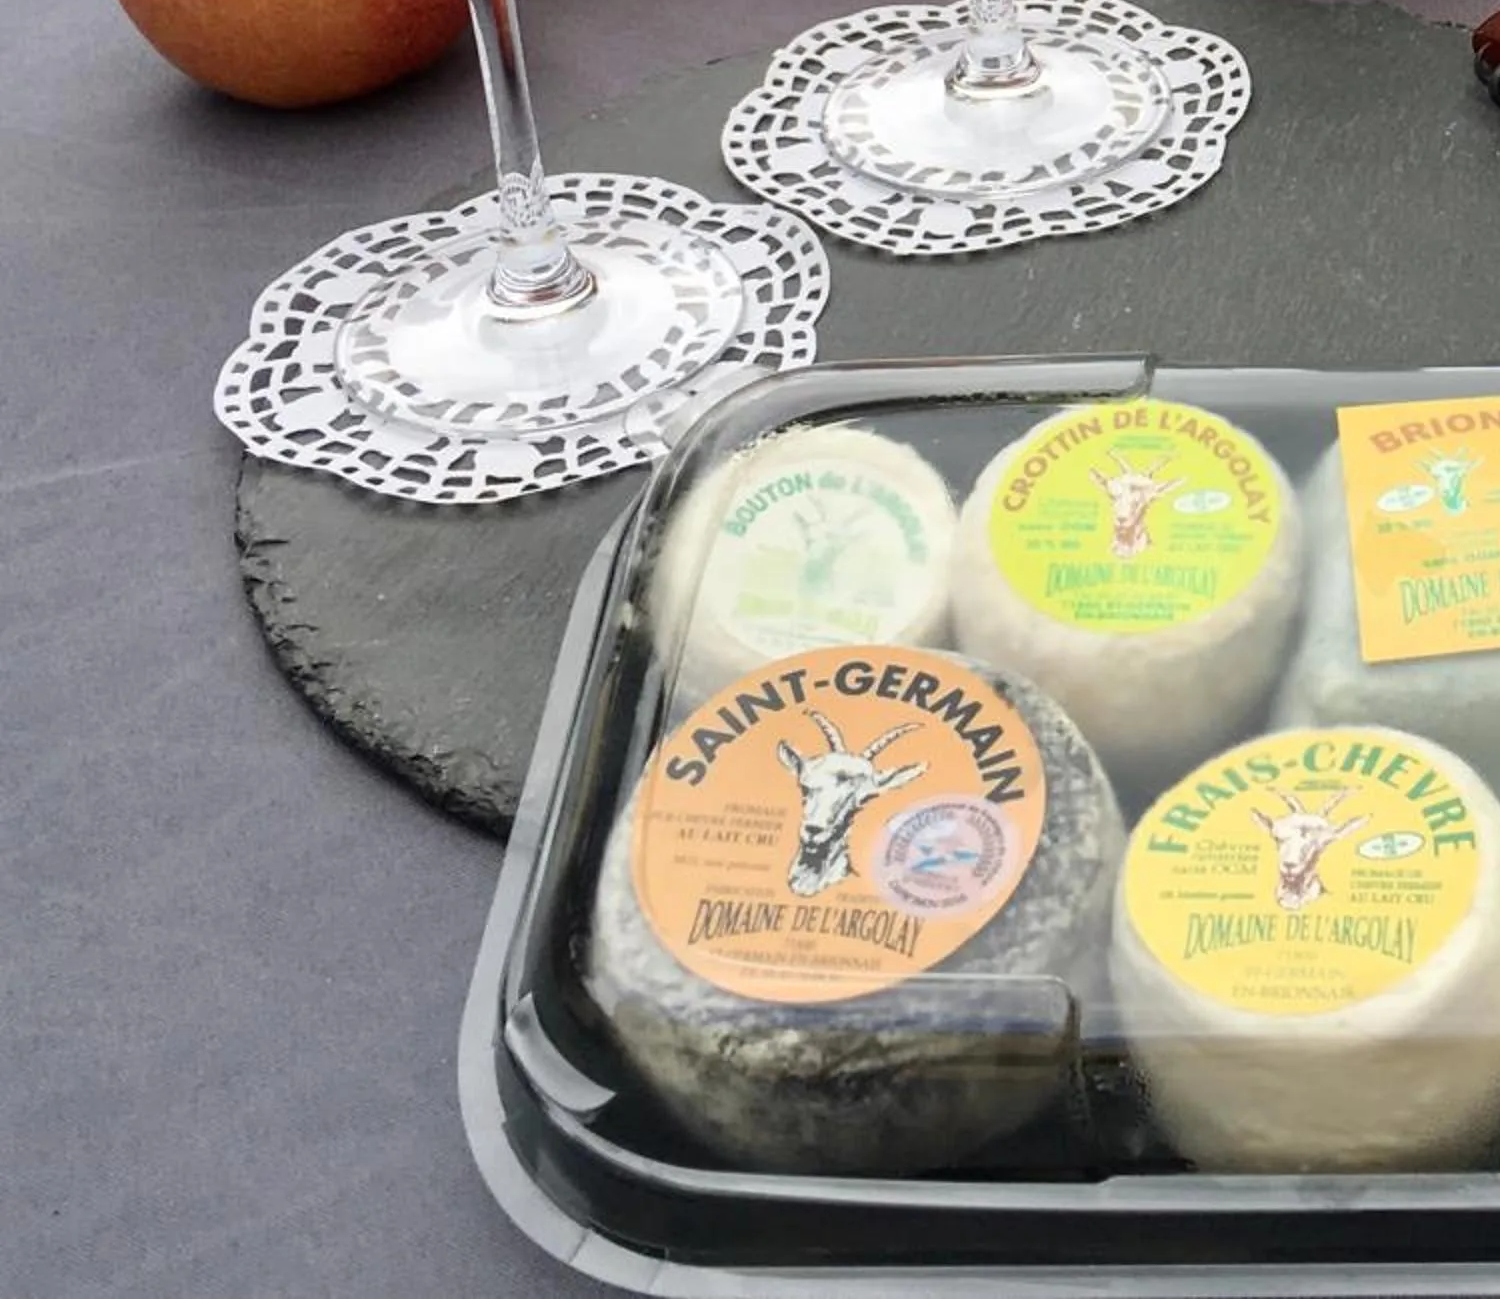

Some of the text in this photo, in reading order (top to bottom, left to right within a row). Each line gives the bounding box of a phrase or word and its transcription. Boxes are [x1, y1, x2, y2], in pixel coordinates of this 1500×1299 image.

[1003, 408, 1271, 524] CROTTIN DE L'ARGOLAY
[725, 473, 813, 537] BOUTON
[1399, 570, 1490, 625] DOMAINE
[666, 660, 1025, 805] SAINT-GERMAIN
[1148, 741, 1477, 857] FRAIS-CHEVRE
[687, 898, 924, 958] DOMAINE DE L'ARGOLAY
[1183, 912, 1418, 964] DOMAINE DE L'ARGOLAY
